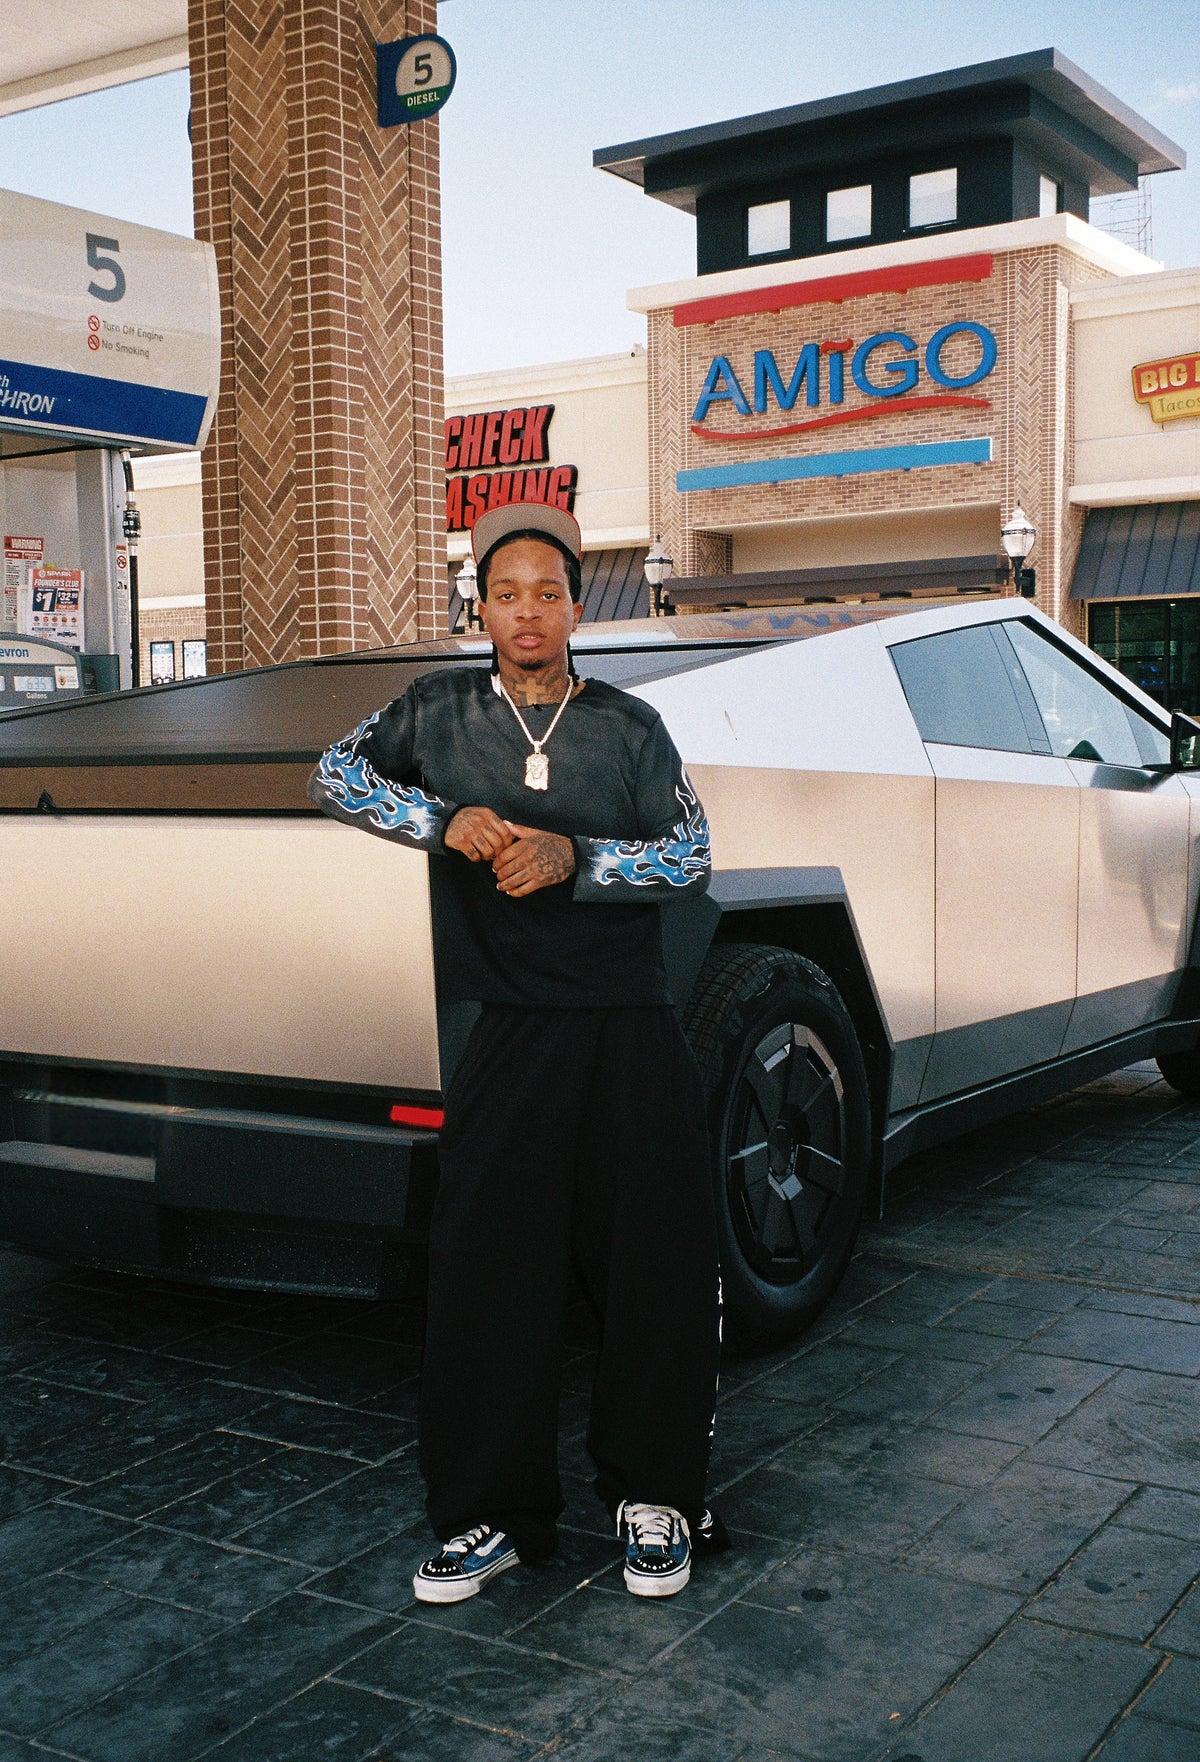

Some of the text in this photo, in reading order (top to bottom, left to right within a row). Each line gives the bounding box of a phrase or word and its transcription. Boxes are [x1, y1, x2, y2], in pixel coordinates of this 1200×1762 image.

[415, 53, 433, 85] 5
[407, 92, 440, 106] DIESEL
[86, 232, 126, 303] 5
[103, 320, 164, 342] Turn Off Engine
[101, 339, 150, 359] No Smoking
[1141, 363, 1188, 394] BIG
[0, 388, 56, 415] HRON
[444, 404, 555, 473] CHECK
[64, 580, 79, 588] CLUB
[35, 592, 54, 612] $1
[0, 648, 29, 658] evron
[26, 692, 48, 700] Gallons
